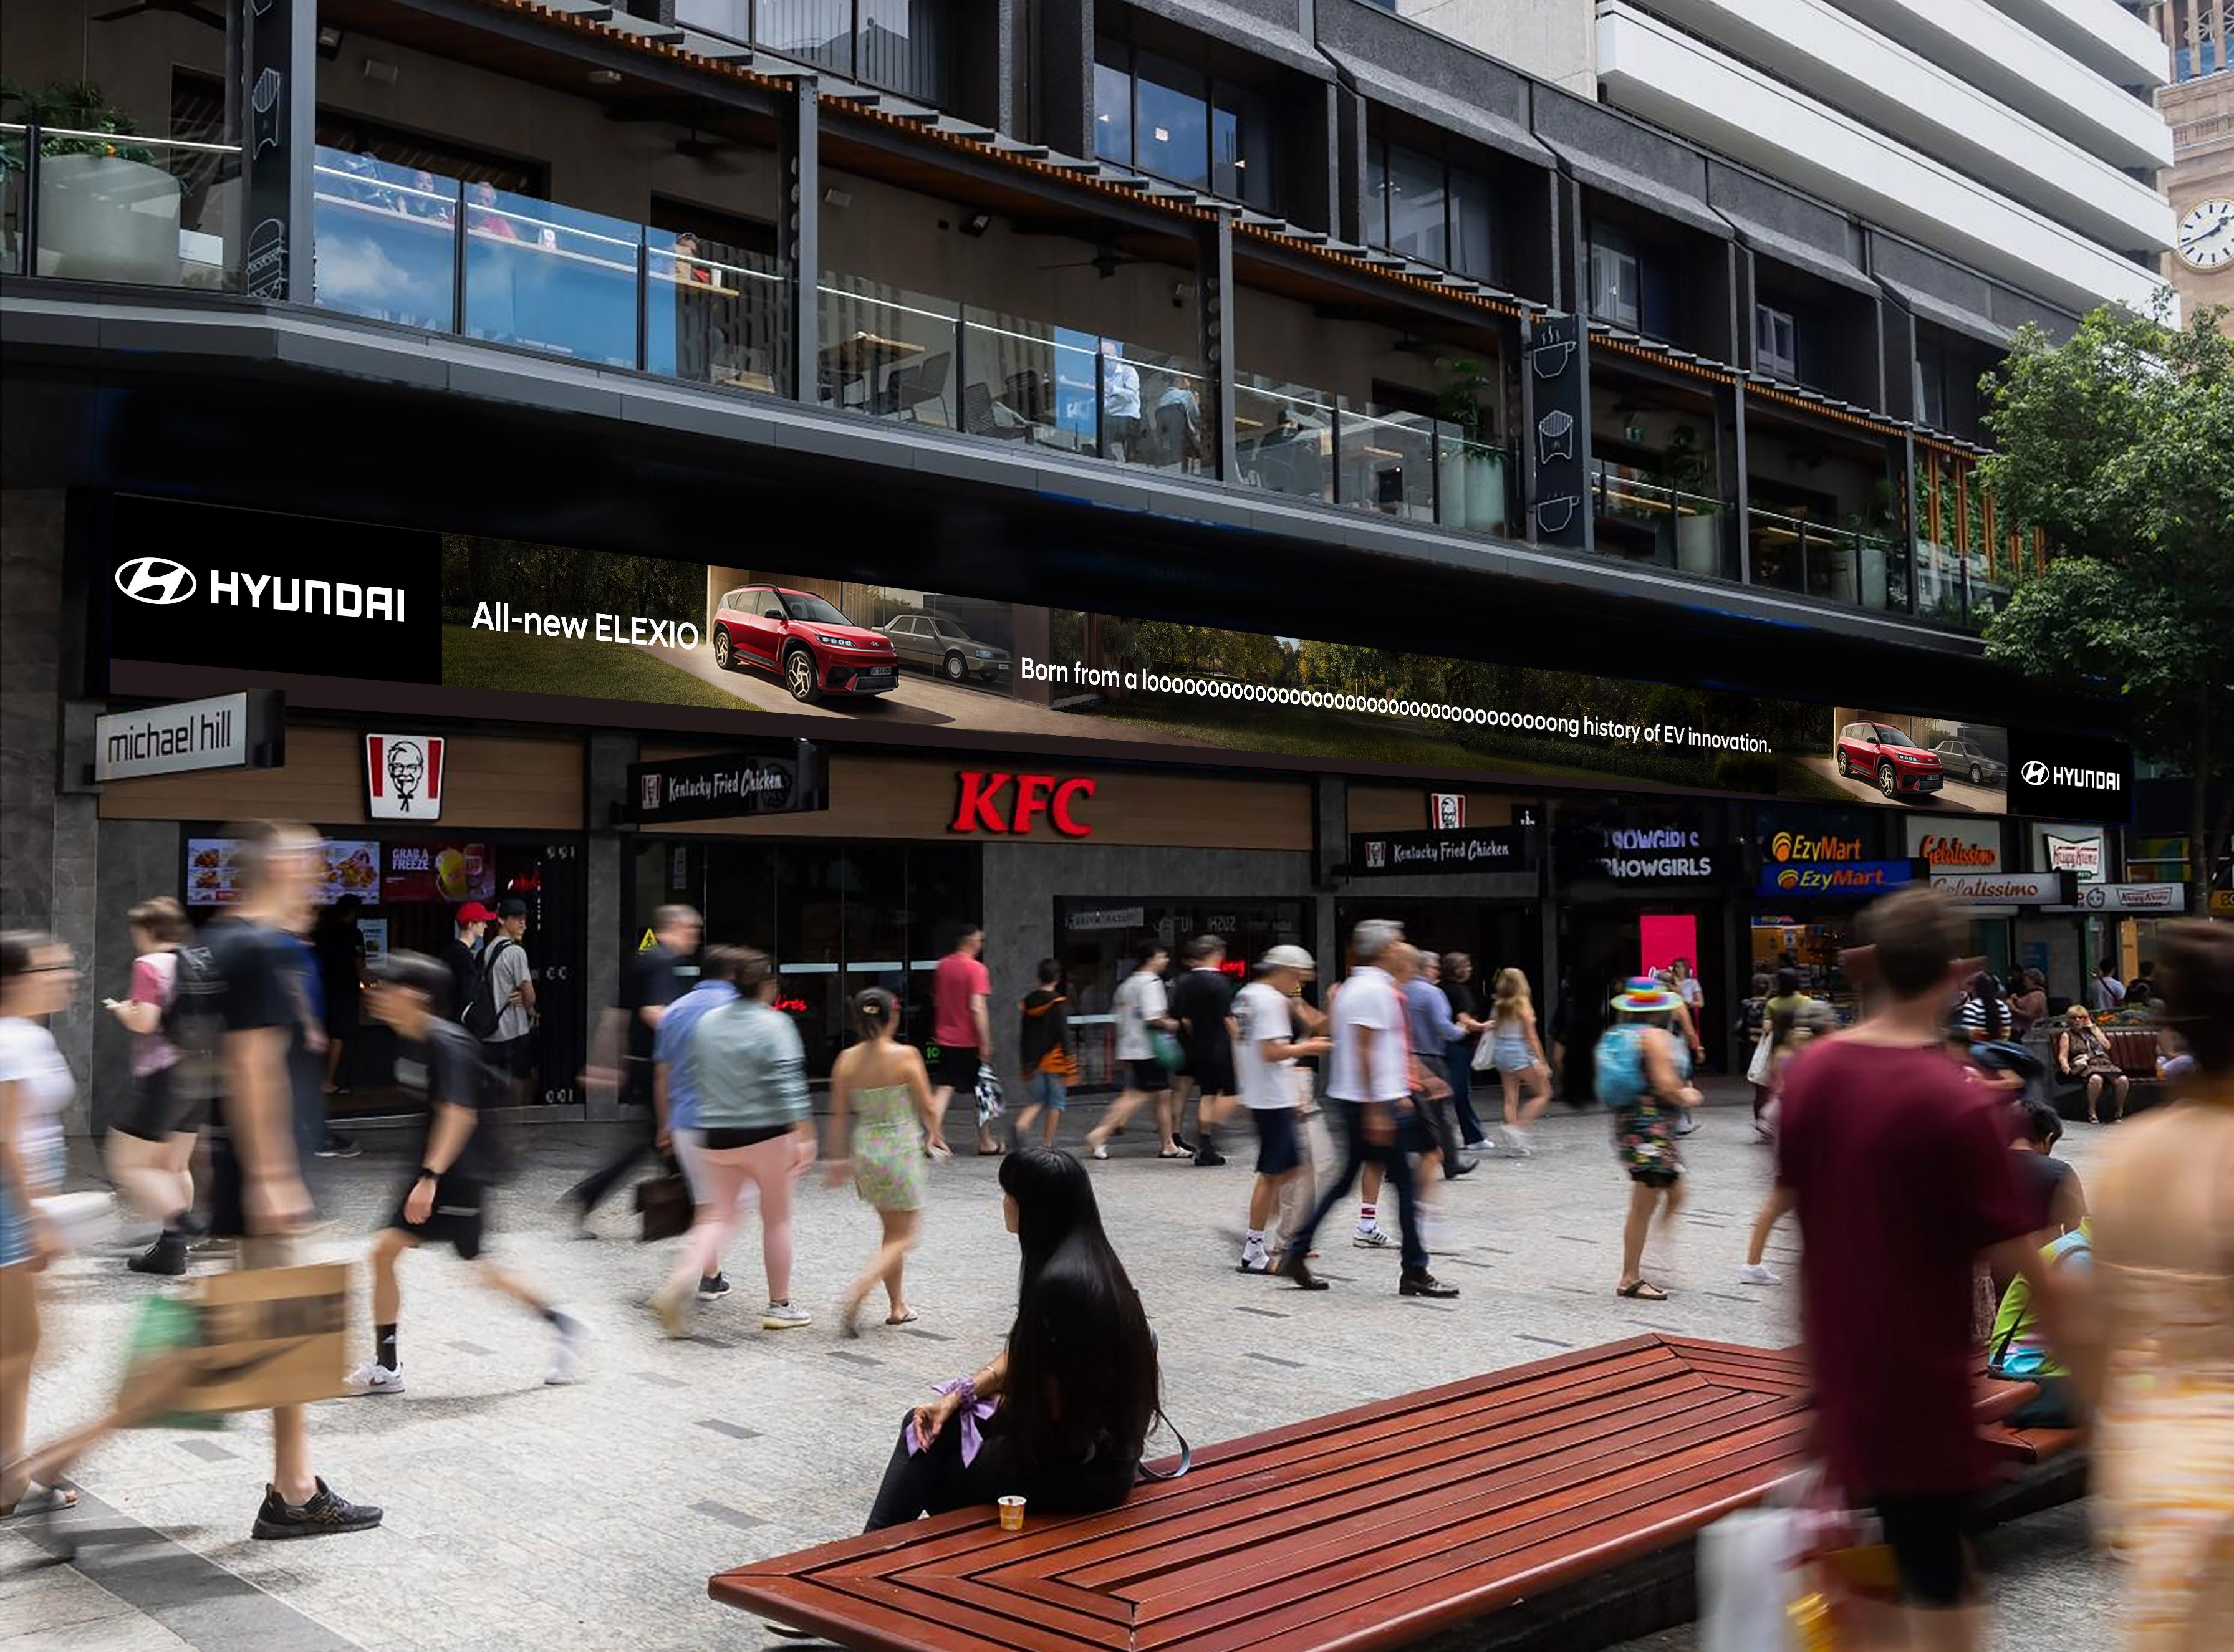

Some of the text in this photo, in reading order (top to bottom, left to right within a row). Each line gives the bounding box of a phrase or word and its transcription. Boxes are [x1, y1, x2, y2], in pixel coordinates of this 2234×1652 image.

[211, 569, 405, 622] HYUNDAI
[471, 601, 699, 650] All-new ELEXIO
[1021, 656, 1068, 683] Born
[1073, 661, 1120, 688] from
[1125, 672, 1137, 689] a
[1584, 716, 1640, 744] history
[1644, 723, 1660, 742] of
[1665, 725, 1685, 744] EV
[1688, 728, 1771, 754] innovation.
[108, 709, 231, 763] michael hill
[668, 767, 782, 803] Kentucky Fried Chicken
[2053, 766, 2120, 791] HYUNDAI
[952, 771, 1096, 836] KFC
[392, 858, 429, 870] FREEZE
[1394, 840, 1510, 863] Kentucky Fried Chicken
[1791, 835, 1862, 862] EzyMart
[1800, 869, 1884, 891] EzyMart
